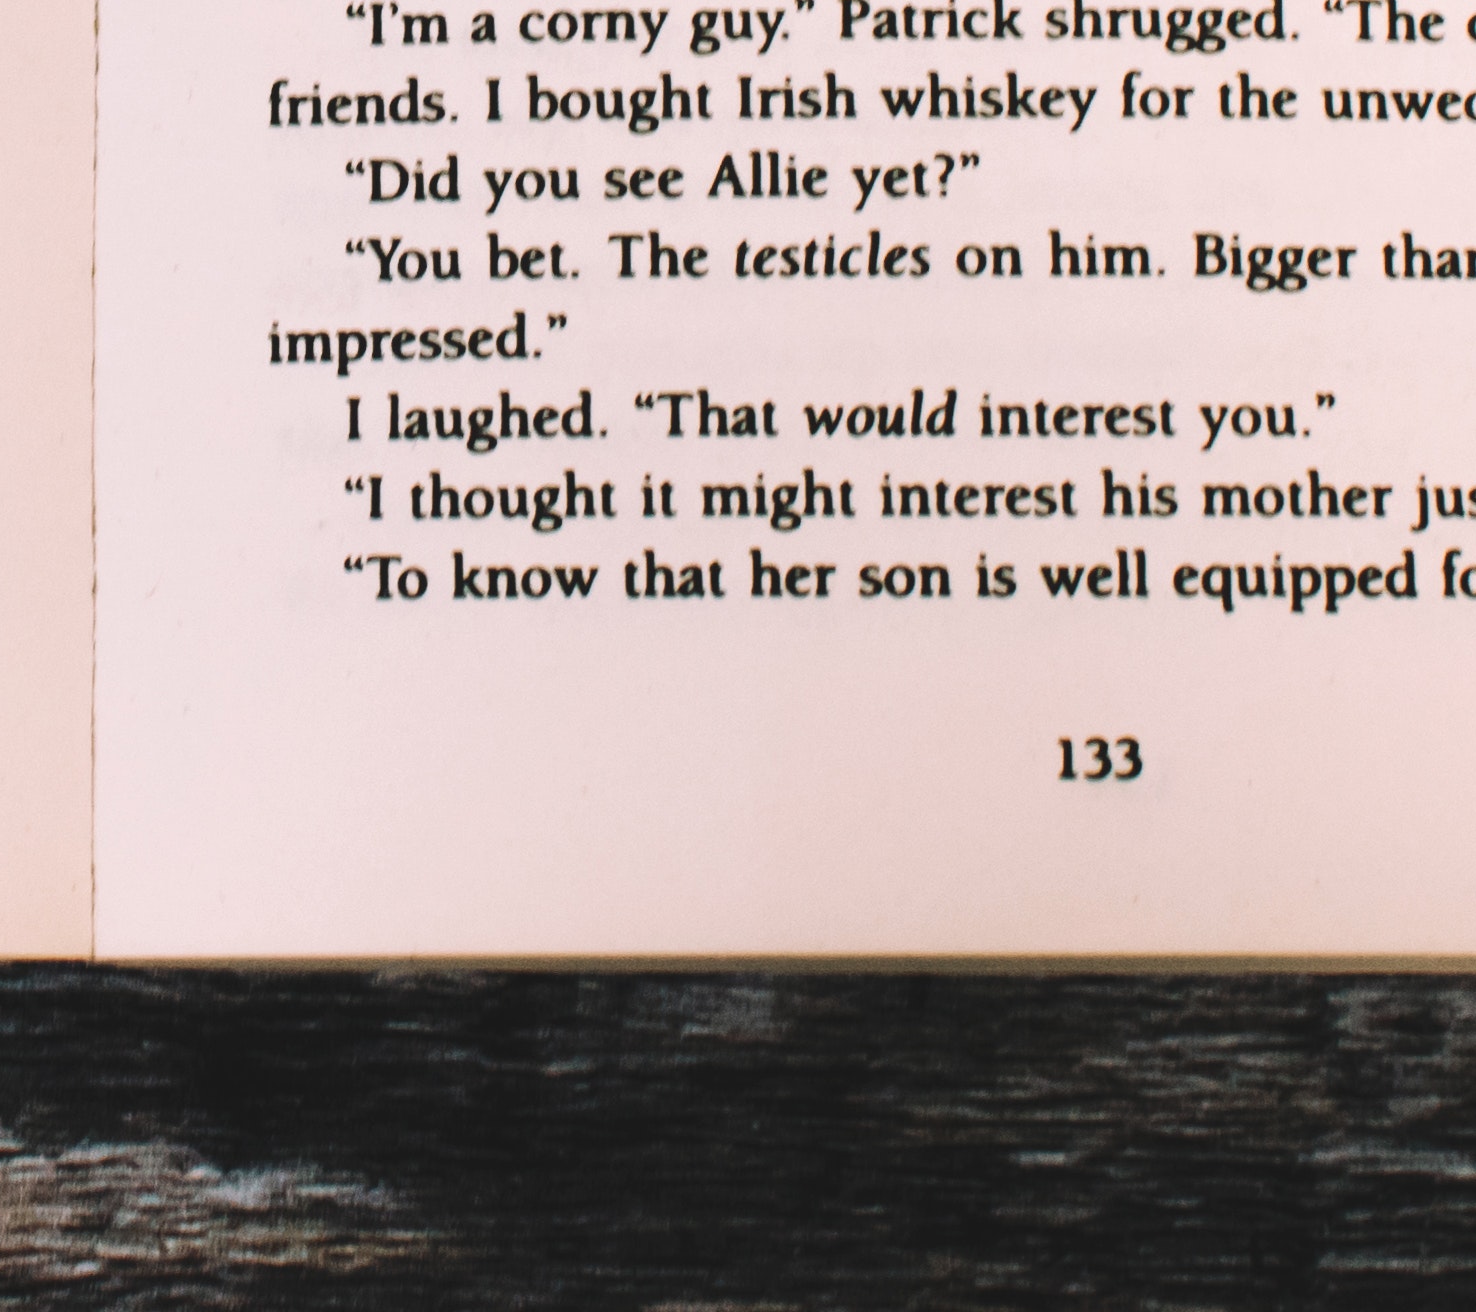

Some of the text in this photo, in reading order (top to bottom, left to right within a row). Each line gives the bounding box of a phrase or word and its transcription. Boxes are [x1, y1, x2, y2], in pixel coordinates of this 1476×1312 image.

[269, 76, 458, 128] friends.
[486, 78, 502, 122] I
[526, 72, 712, 136] bought
[738, 71, 857, 120] Irish
[880, 70, 1097, 133] whiskey
[1122, 70, 1195, 119] for
[1219, 71, 1297, 120] the
[345, 150, 980, 216] “Did you see Allie yet?”
[268, 310, 567, 378] impressed.”
[344, 554, 428, 601] “To
[452, 550, 598, 600] know
[624, 548, 726, 600] that
[749, 547, 836, 599] her
[859, 564, 952, 599] son
[976, 553, 1017, 599] is
[1040, 548, 1149, 599] well
[1173, 548, 1418, 615] equipped
[1059, 736, 1144, 783] 133
